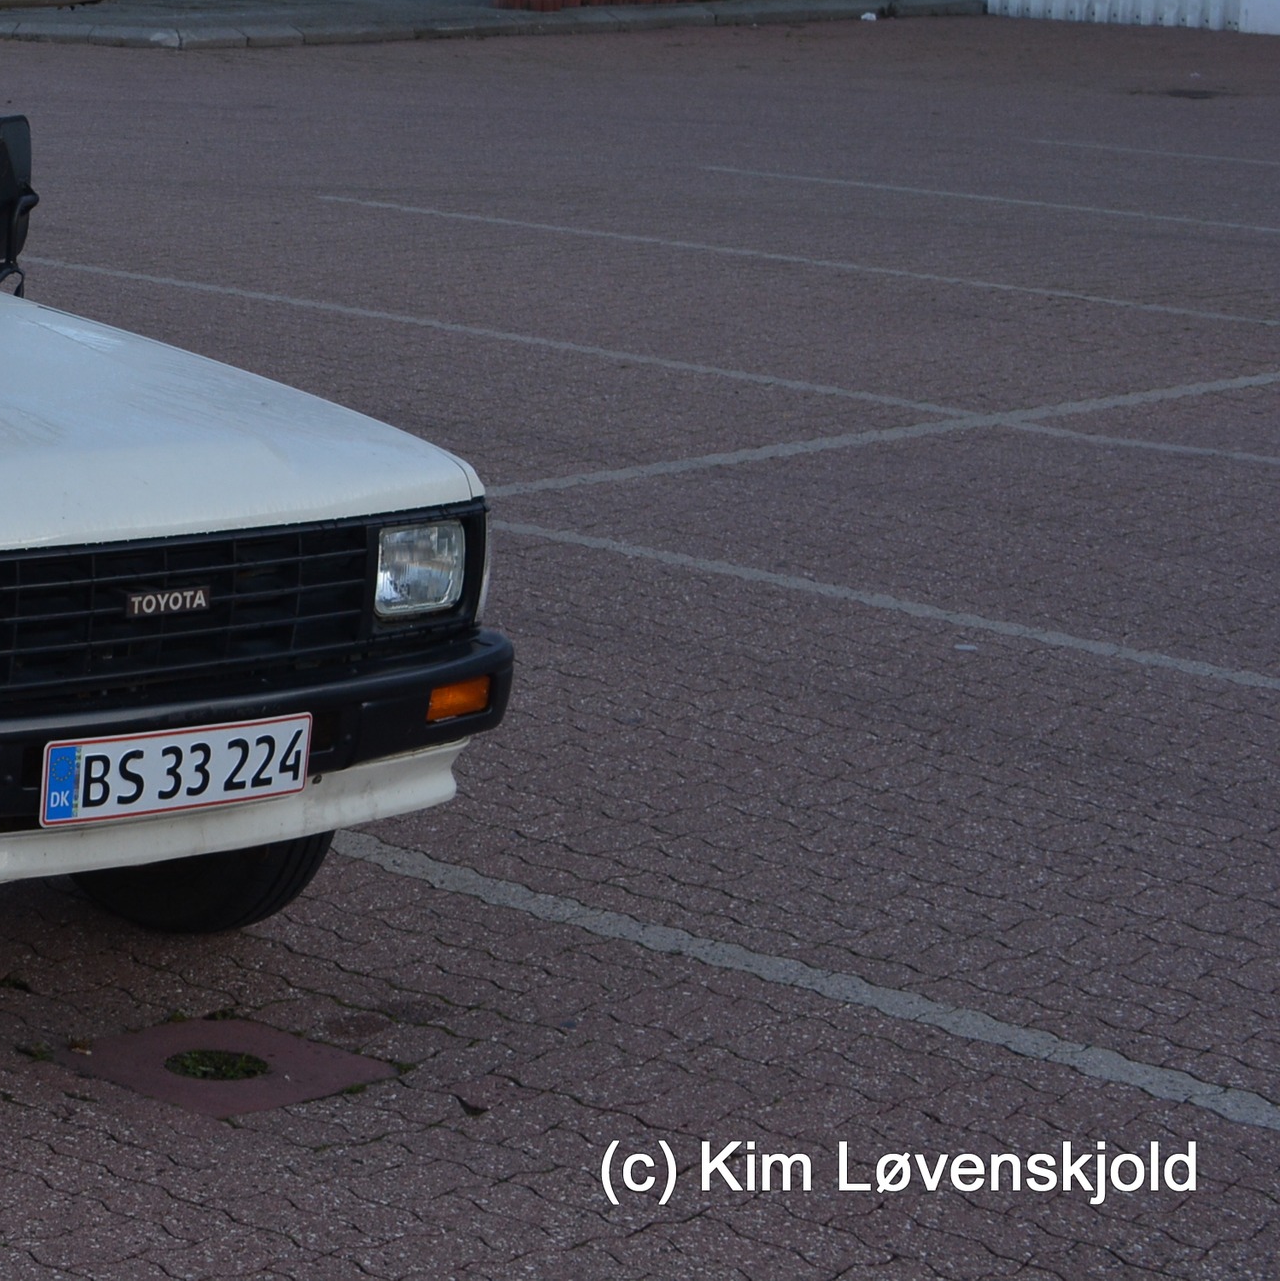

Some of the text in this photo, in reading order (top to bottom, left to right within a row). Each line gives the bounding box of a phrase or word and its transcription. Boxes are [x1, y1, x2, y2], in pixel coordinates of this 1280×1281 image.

[130, 589, 207, 615] TOYOTA
[81, 728, 303, 809] BS 33 224
[50, 790, 70, 808] DK
